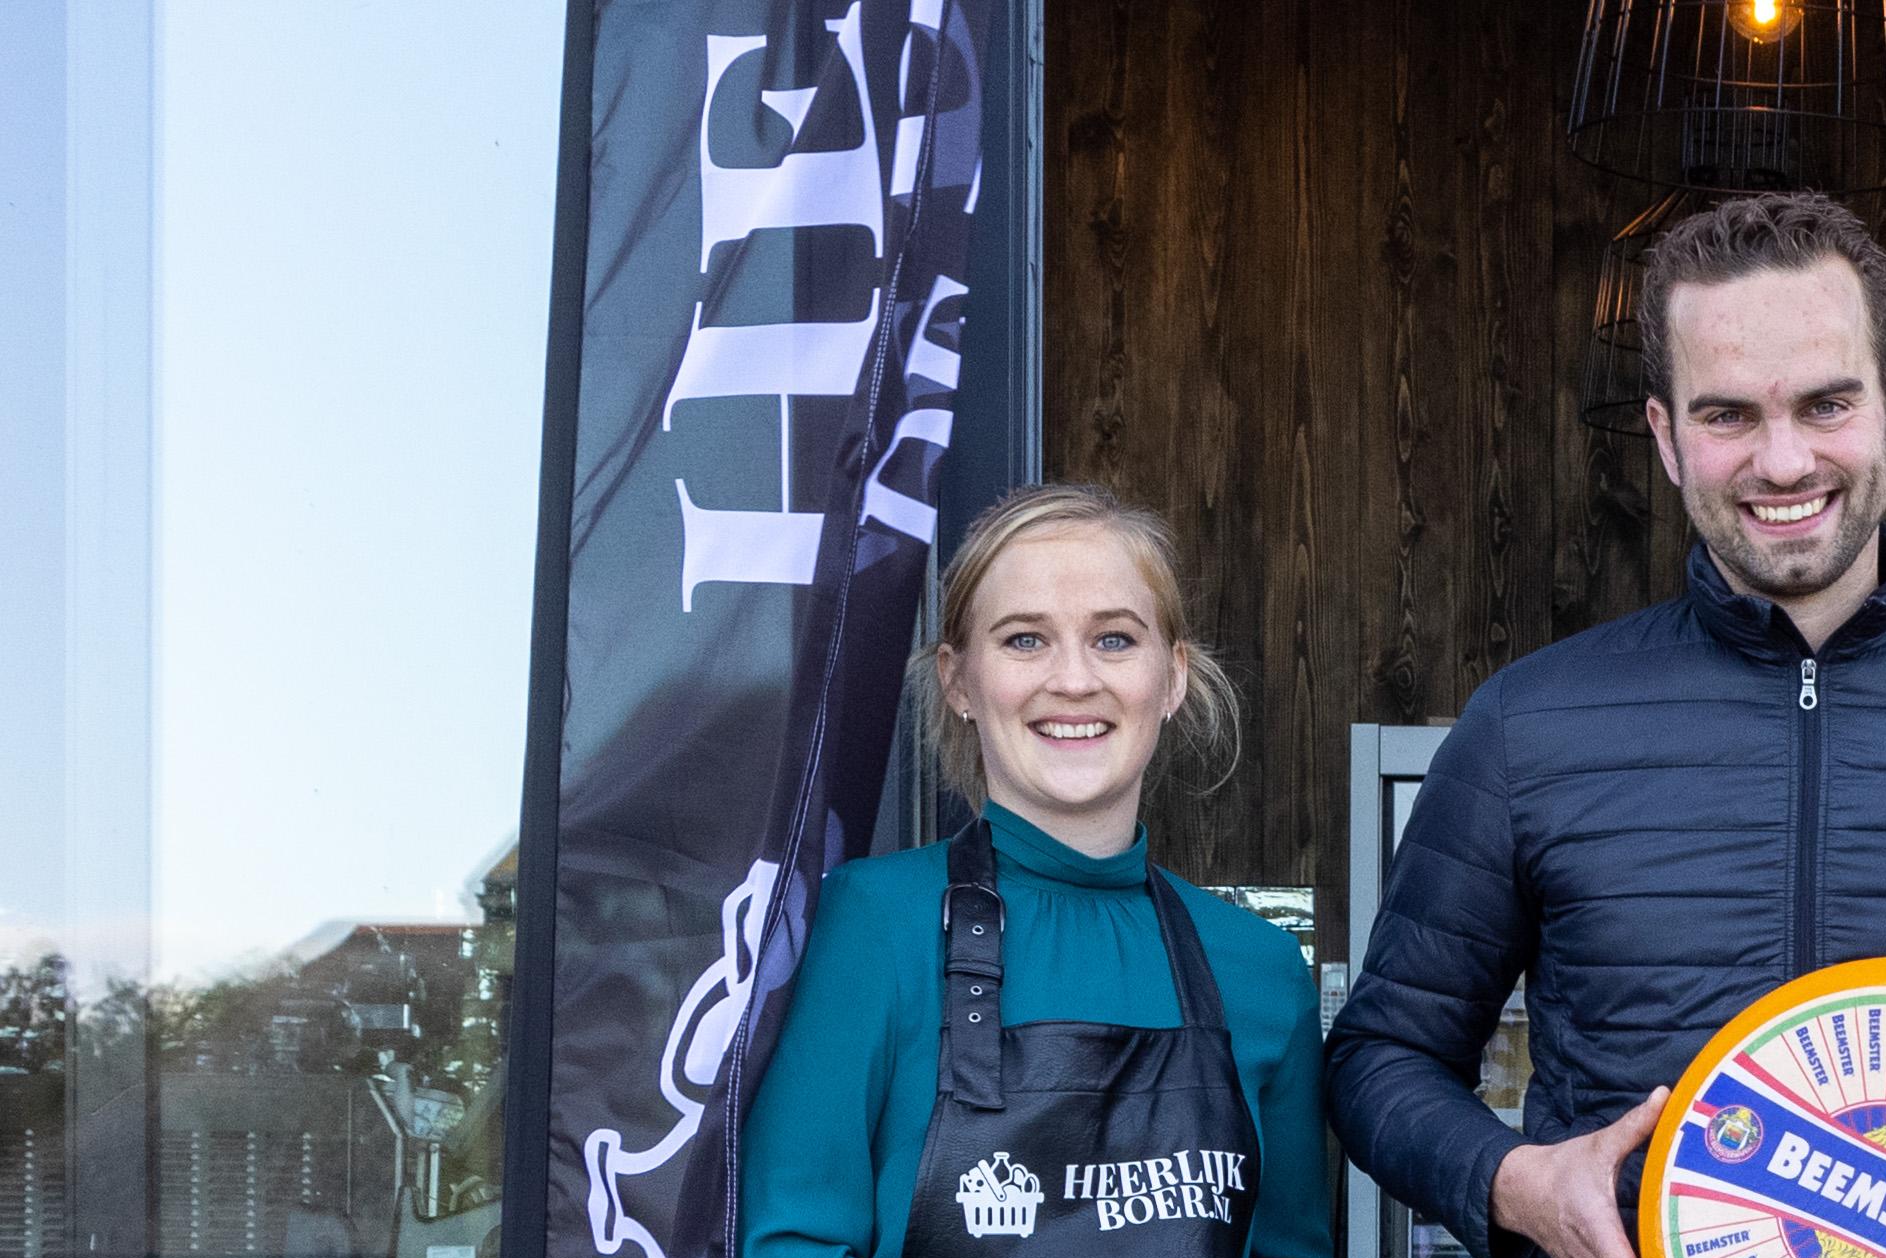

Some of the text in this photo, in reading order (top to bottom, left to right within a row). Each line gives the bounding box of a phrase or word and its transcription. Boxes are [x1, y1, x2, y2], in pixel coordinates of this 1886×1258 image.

[1796, 1026, 1829, 1086] BEEMSTER
[1832, 1014, 1854, 1076] BEEMSTER
[1869, 1008, 1881, 1071] BEEMSTER
[1063, 1149, 1247, 1200] HEERLIJK
[1096, 1184, 1232, 1231] BOER.NL
[1686, 1230, 1751, 1257] BEEMSTER
